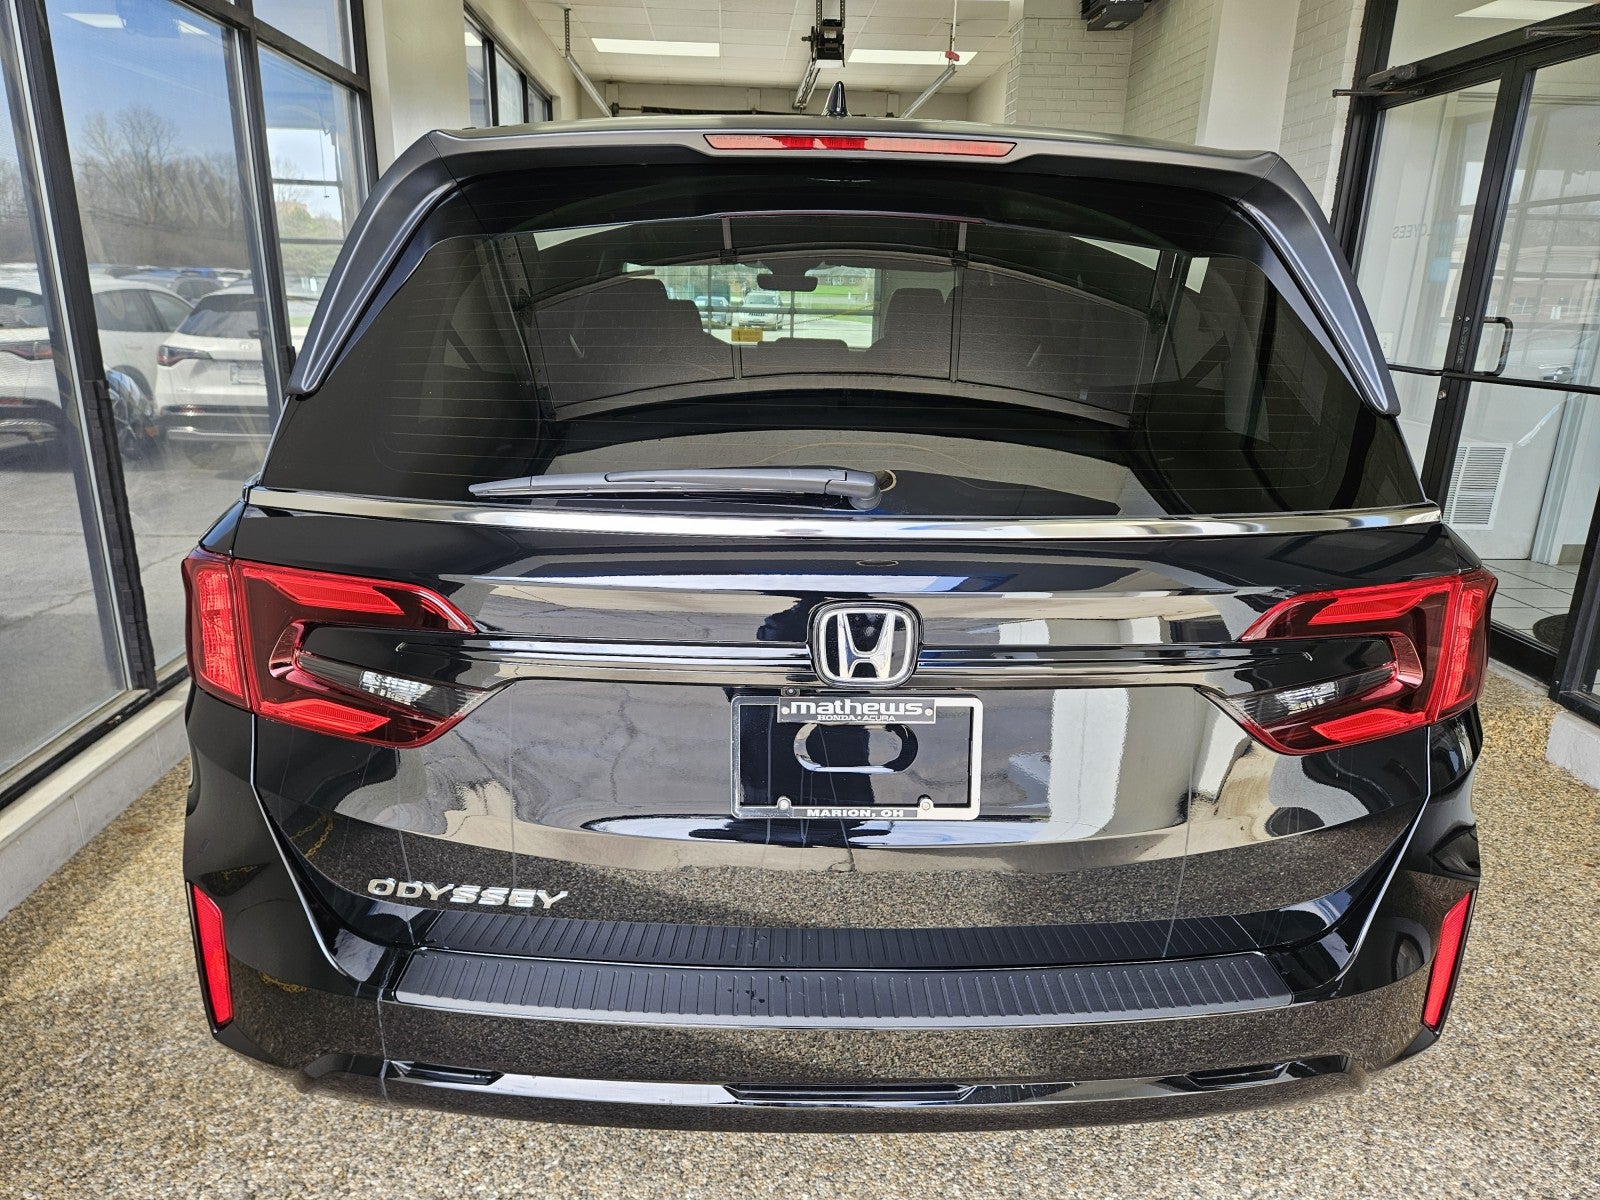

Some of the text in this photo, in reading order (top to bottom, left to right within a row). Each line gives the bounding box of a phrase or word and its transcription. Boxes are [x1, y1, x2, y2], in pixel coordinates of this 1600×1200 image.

[1456, 326, 1468, 364] PUSH
[790, 699, 923, 715] mathews
[806, 809, 904, 818] MARION, OH
[367, 877, 569, 909] ODYSSEY
